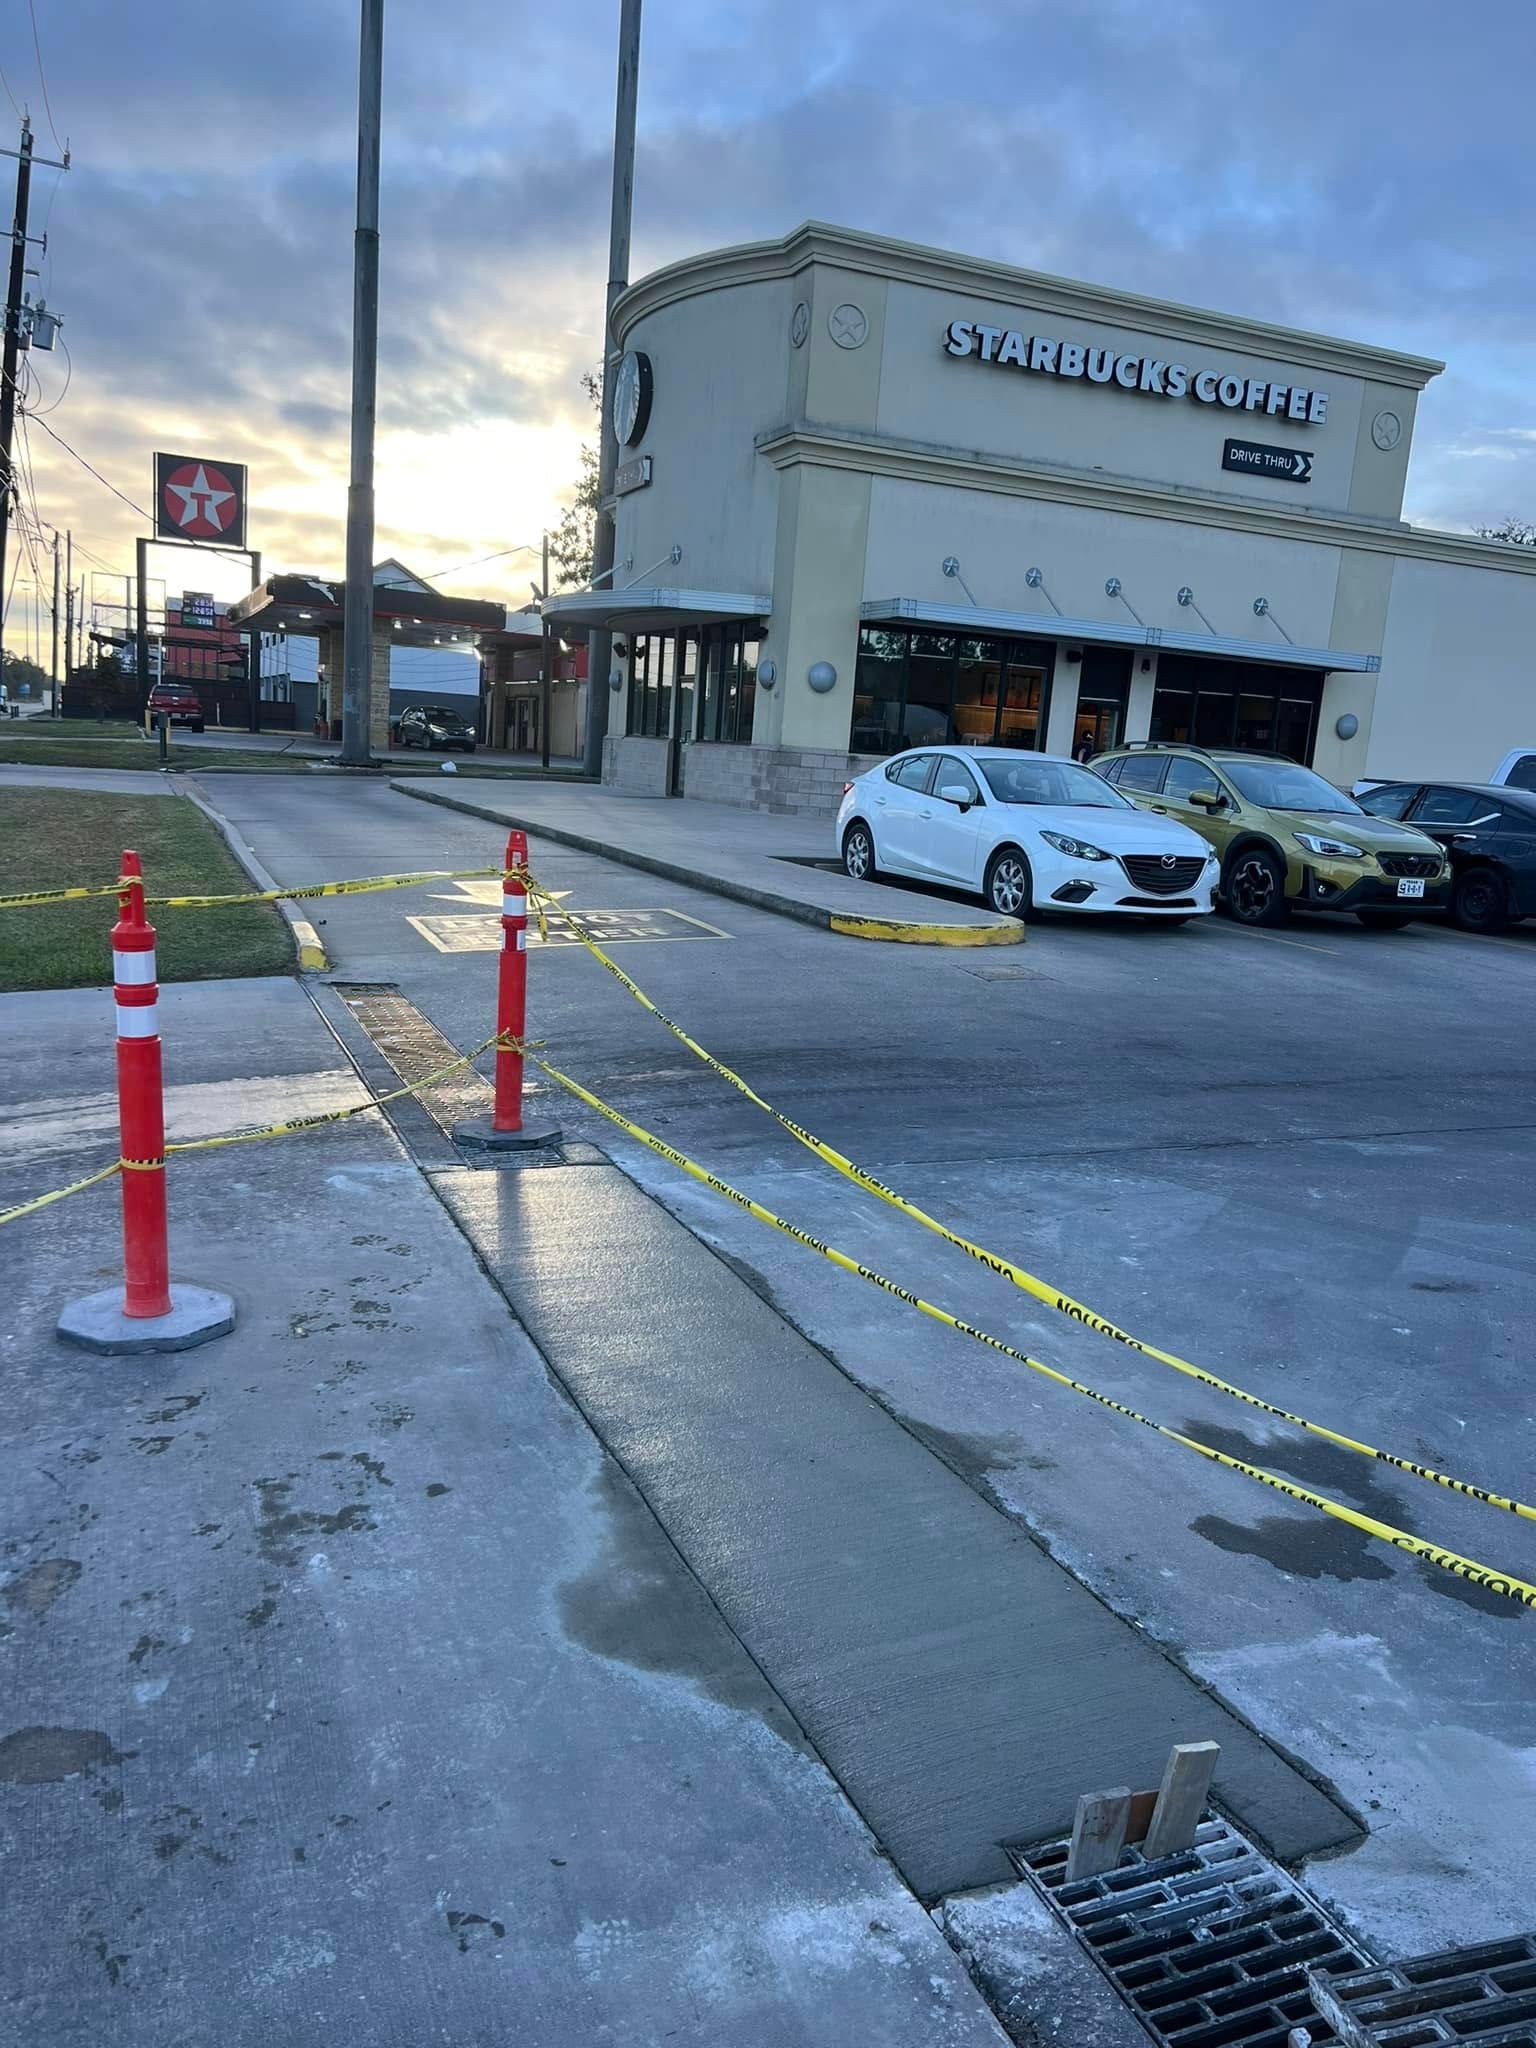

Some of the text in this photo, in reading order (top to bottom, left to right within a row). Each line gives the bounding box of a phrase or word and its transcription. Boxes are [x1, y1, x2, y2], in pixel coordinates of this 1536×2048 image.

[946, 319, 1331, 425] STARBUCKS COFFEE
[1230, 447, 1292, 470] DRIVE THRU
[857, 1264, 921, 1308] CAUTION
[1391, 1535, 1536, 1608] CAUTION
